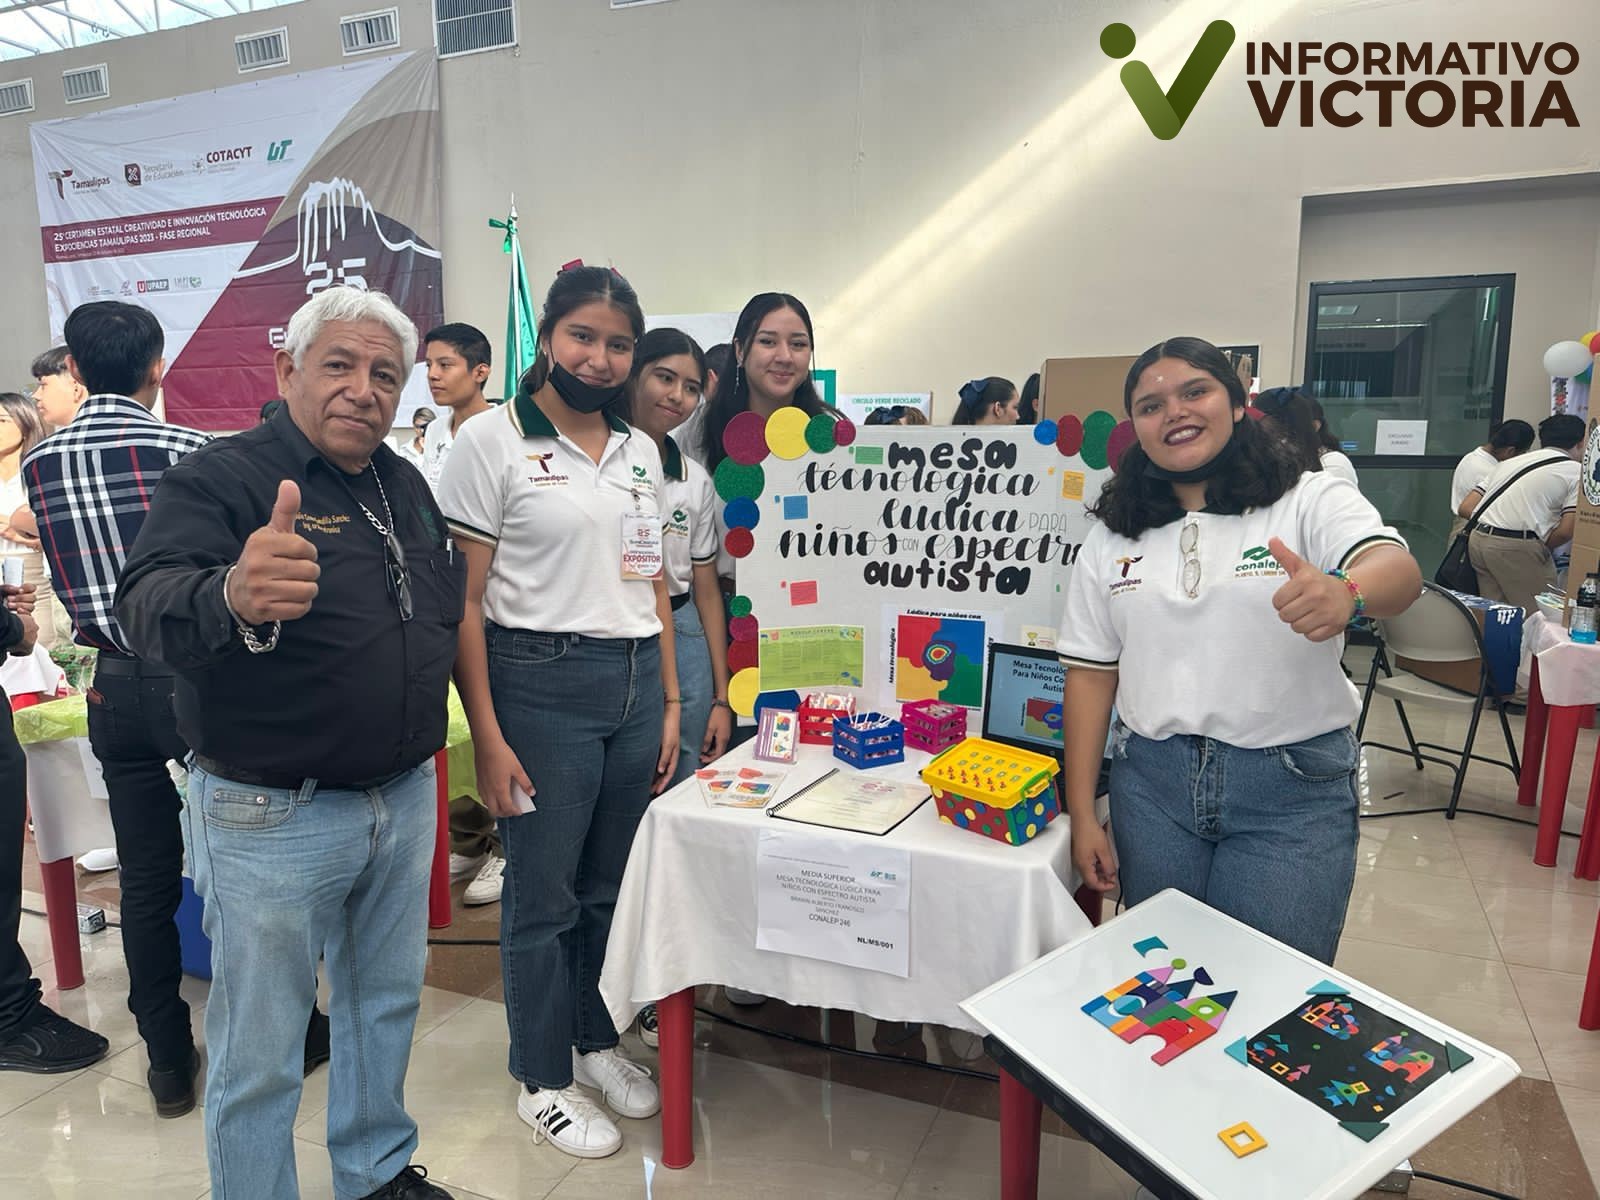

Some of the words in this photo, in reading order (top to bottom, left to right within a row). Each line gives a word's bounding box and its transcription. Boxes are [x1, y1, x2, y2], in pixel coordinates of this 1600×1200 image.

[206, 146, 252, 163] COTACYT
[70, 176, 111, 189] Tamaulipas
[65, 228, 97, 240] CERTAMEN
[97, 225, 124, 236] ESTATAL
[124, 219, 167, 232] CREATIVIDAD
[168, 219, 173, 228] E
[173, 211, 216, 227] INNOVACIÓN
[217, 206, 267, 221] TECNOLÓGICA
[55, 240, 98, 252] EXPOCIENCIAS
[99, 234, 139, 247] TAMAULIPAS
[160, 230, 176, 240] FASE
[177, 226, 211, 239] REGIONAL
[888, 438, 1017, 470] mesa
[528, 473, 569, 484] Tamaulipas
[1029, 512, 1068, 533] PARA
[775, 523, 902, 559] niños
[623, 553, 661, 564] EXPOSITOR
[864, 558, 1032, 595] autista
[1013, 660, 1032, 670] Mesa
[1013, 669, 1028, 679] Para
[1031, 671, 1052, 682] Niños
[1054, 675, 1064, 683] Co
[776, 873, 795, 882] MESA
[795, 876, 839, 890] TECNOLÓGICA
[864, 887, 881, 897] PARA
[801, 869, 823, 879] MEDIA
[823, 873, 856, 883] SUPERIOR
[781, 882, 802, 891] NIÑOS
[802, 886, 817, 895] CON
[817, 888, 849, 899] ESPECTRO
[850, 894, 876, 904] AUTISTA
[809, 913, 839, 925] CONALEP
